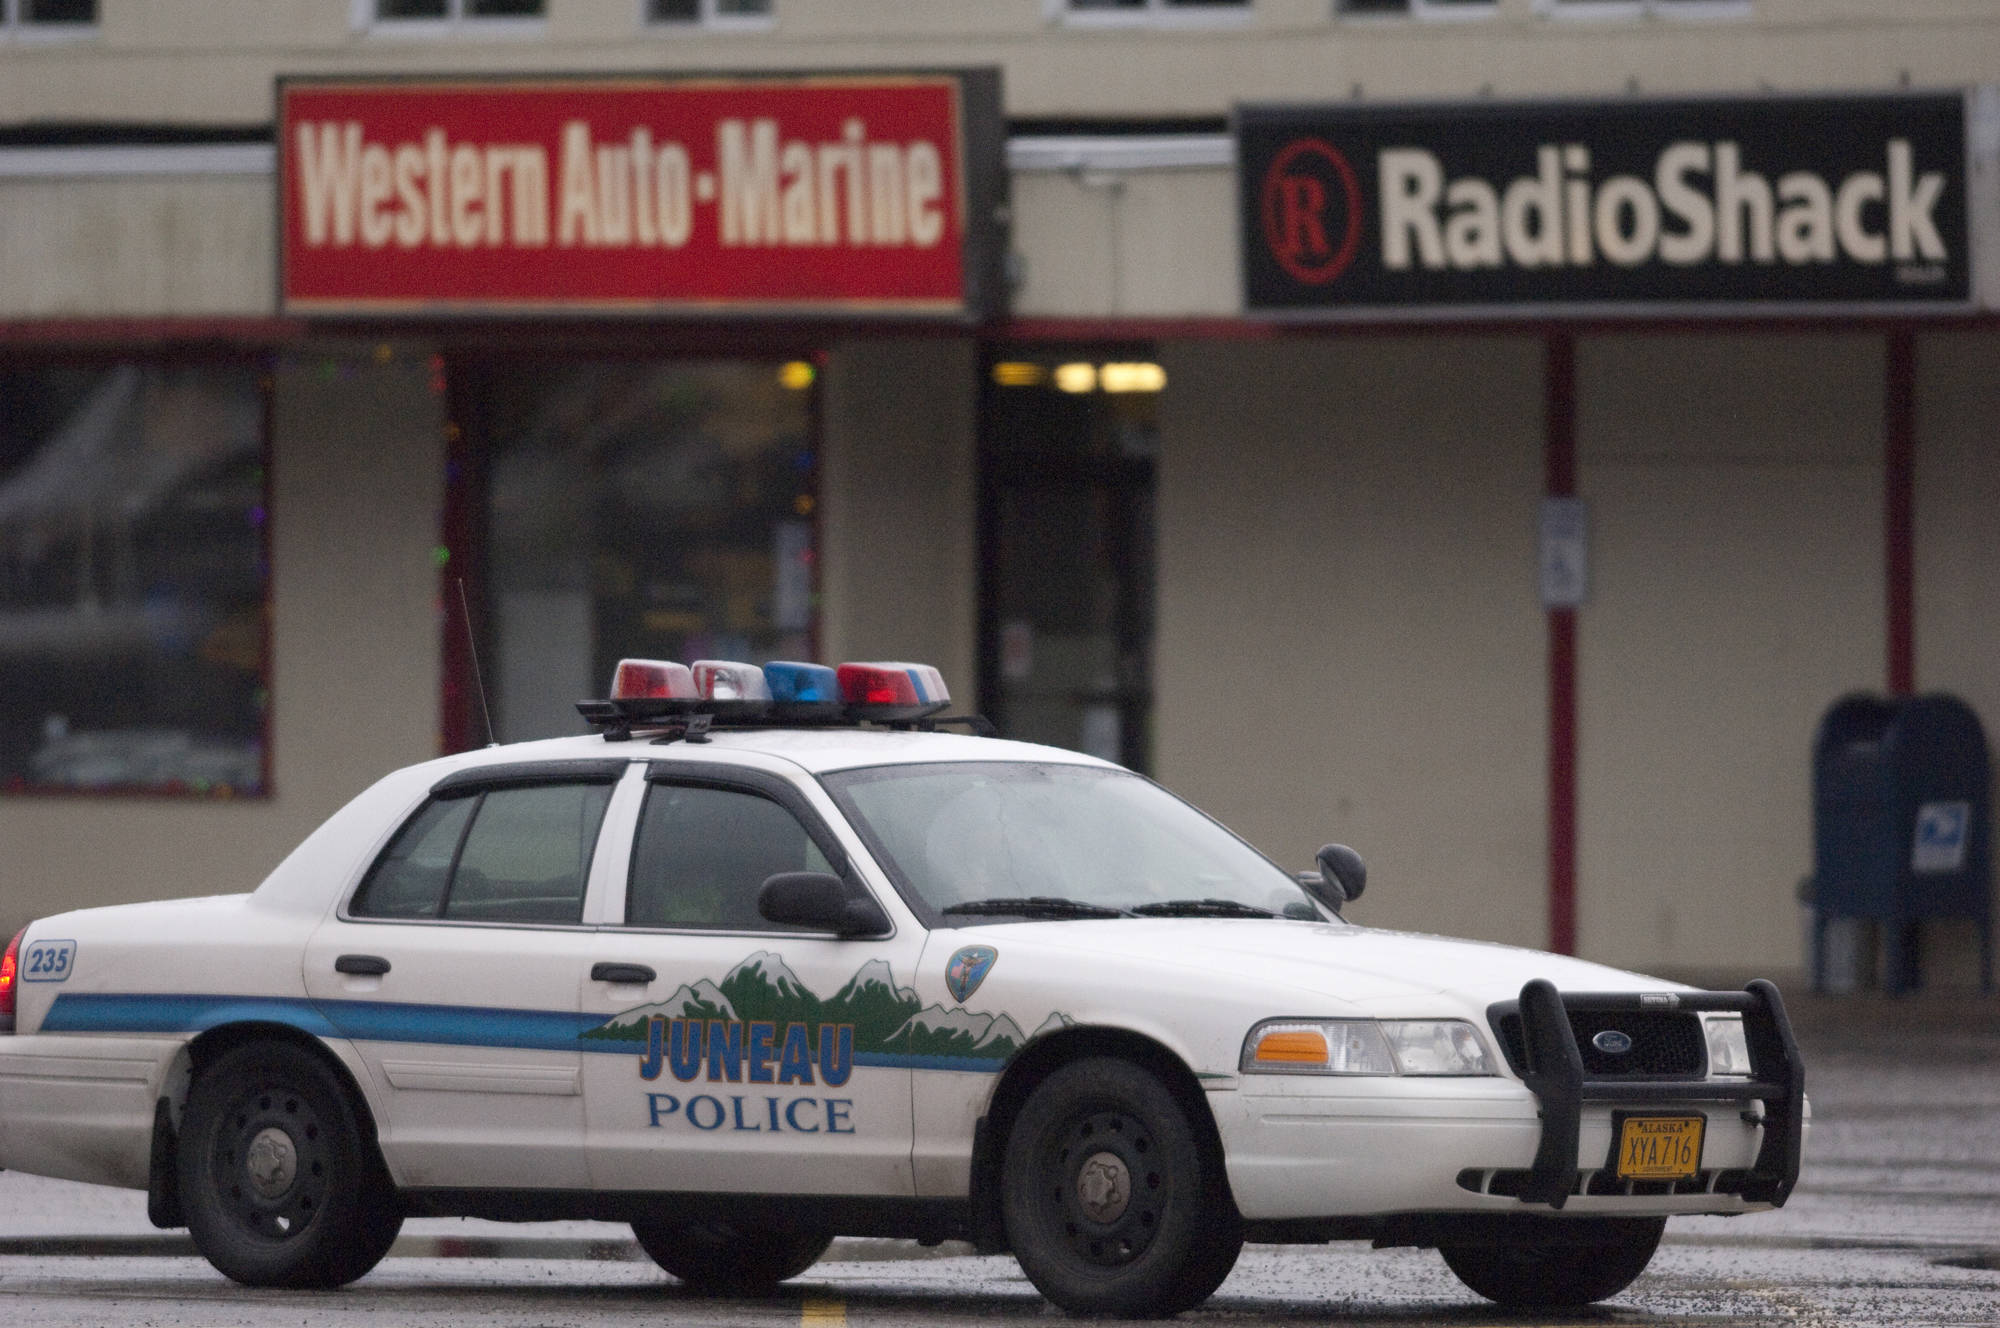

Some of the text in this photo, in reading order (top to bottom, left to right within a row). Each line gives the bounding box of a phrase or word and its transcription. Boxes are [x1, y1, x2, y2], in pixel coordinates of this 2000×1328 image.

[299, 122, 548, 247] Western
[1378, 138, 1948, 270] RadioShack
[29, 947, 69, 973] 235
[639, 1016, 855, 1087] JUNEAU
[645, 1092, 856, 1134] POLICE
[1641, 1122, 1684, 1134] ALASKA
